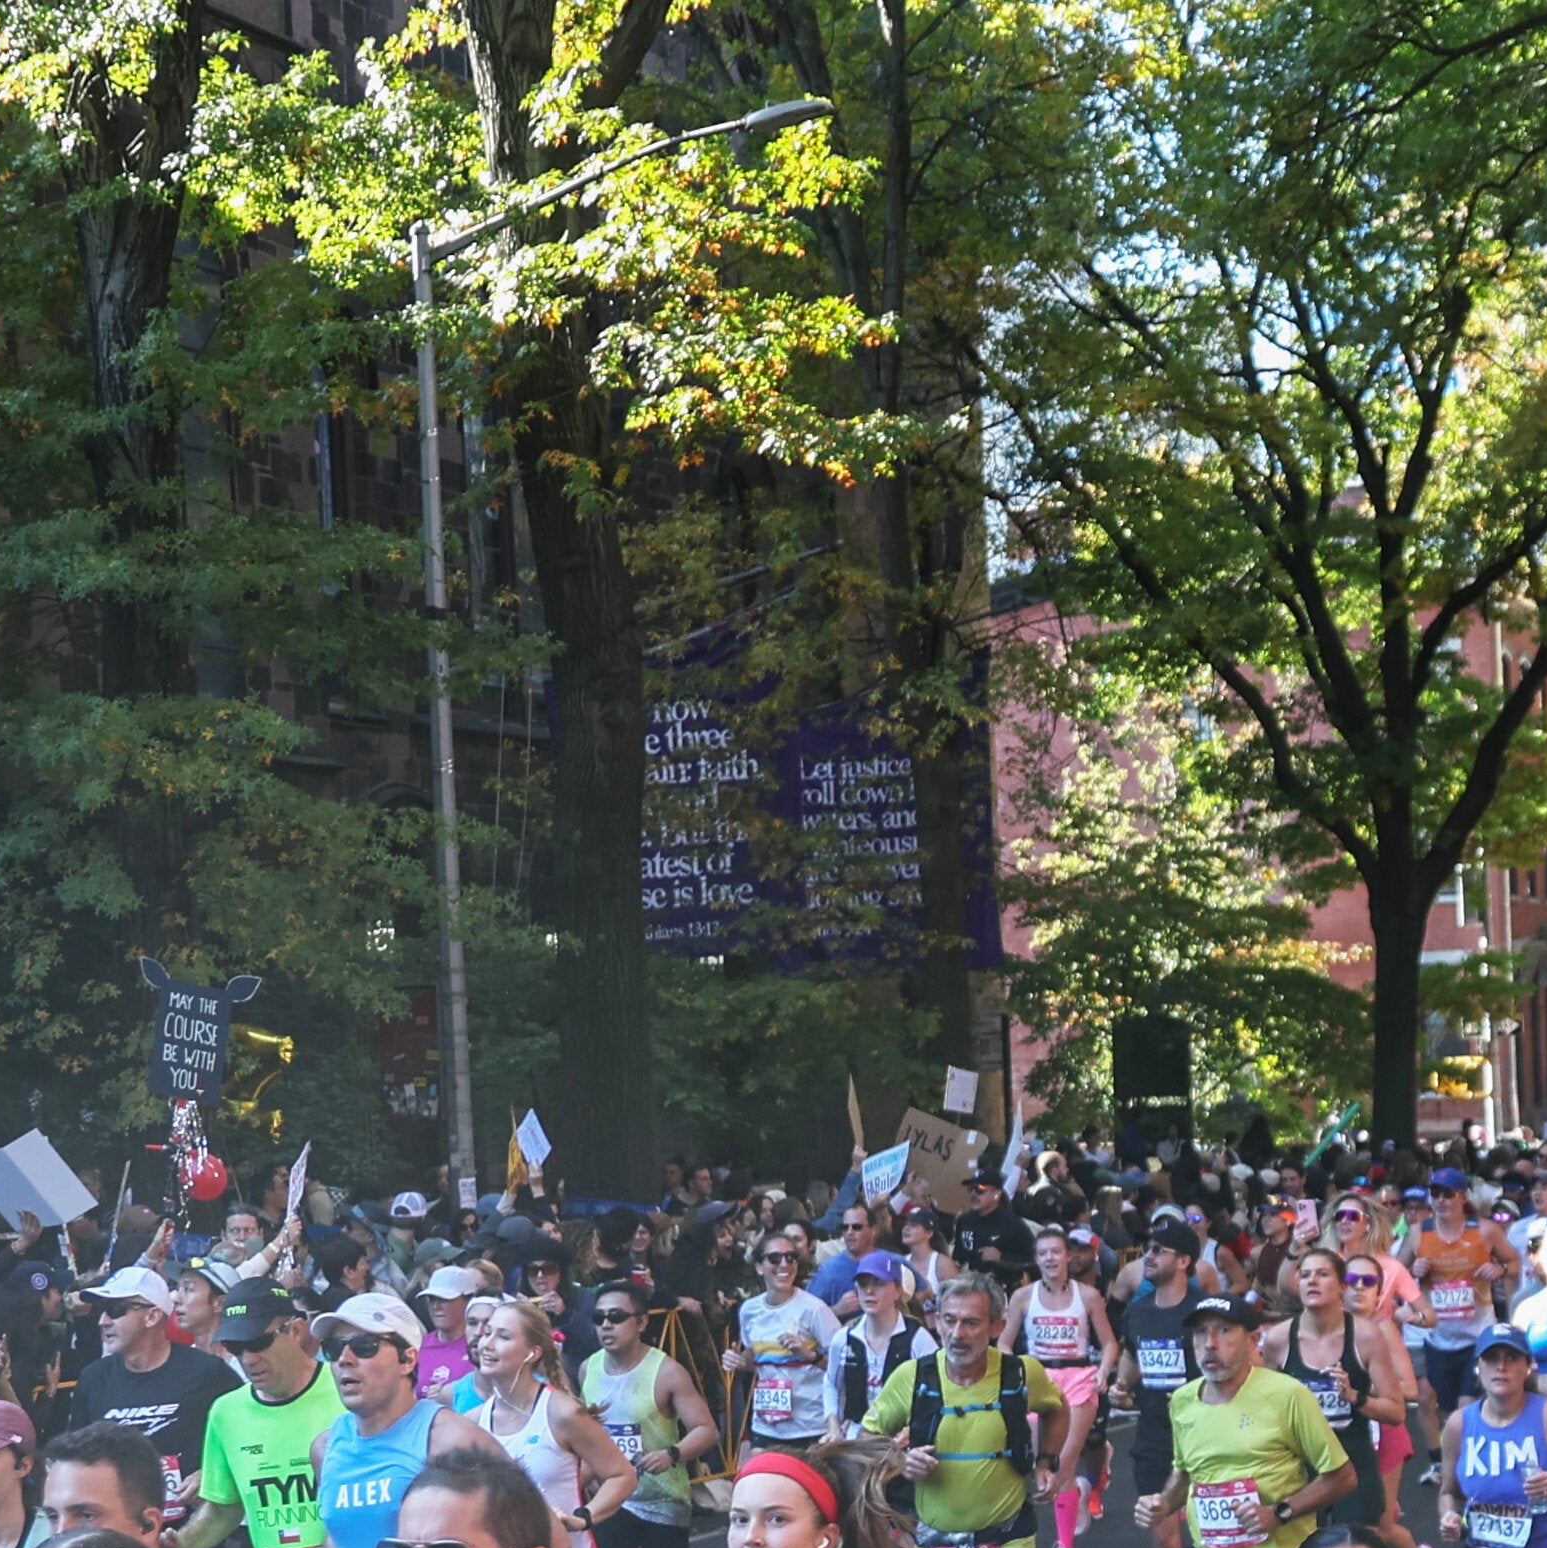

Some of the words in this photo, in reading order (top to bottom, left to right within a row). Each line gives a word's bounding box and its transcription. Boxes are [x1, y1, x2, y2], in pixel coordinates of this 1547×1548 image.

[665, 722, 733, 753] three
[800, 757, 834, 781] Let
[839, 757, 912, 786] justice
[801, 780, 835, 806] roll
[672, 881, 694, 908] is
[169, 991, 194, 1011] MAY
[199, 997, 219, 1016] THE
[163, 1012, 219, 1047] COURSE
[163, 1043, 178, 1062] BE
[184, 1047, 216, 1072] WITH
[170, 1066, 198, 1090] YOU
[226, 1304, 248, 1317] TYM
[1197, 1297, 1231, 1311] HOKA
[104, 1403, 180, 1419] NIKE
[755, 1390, 788, 1406] 28345
[1465, 1435, 1539, 1477] KIM
[335, 1476, 393, 1509] ALEX
